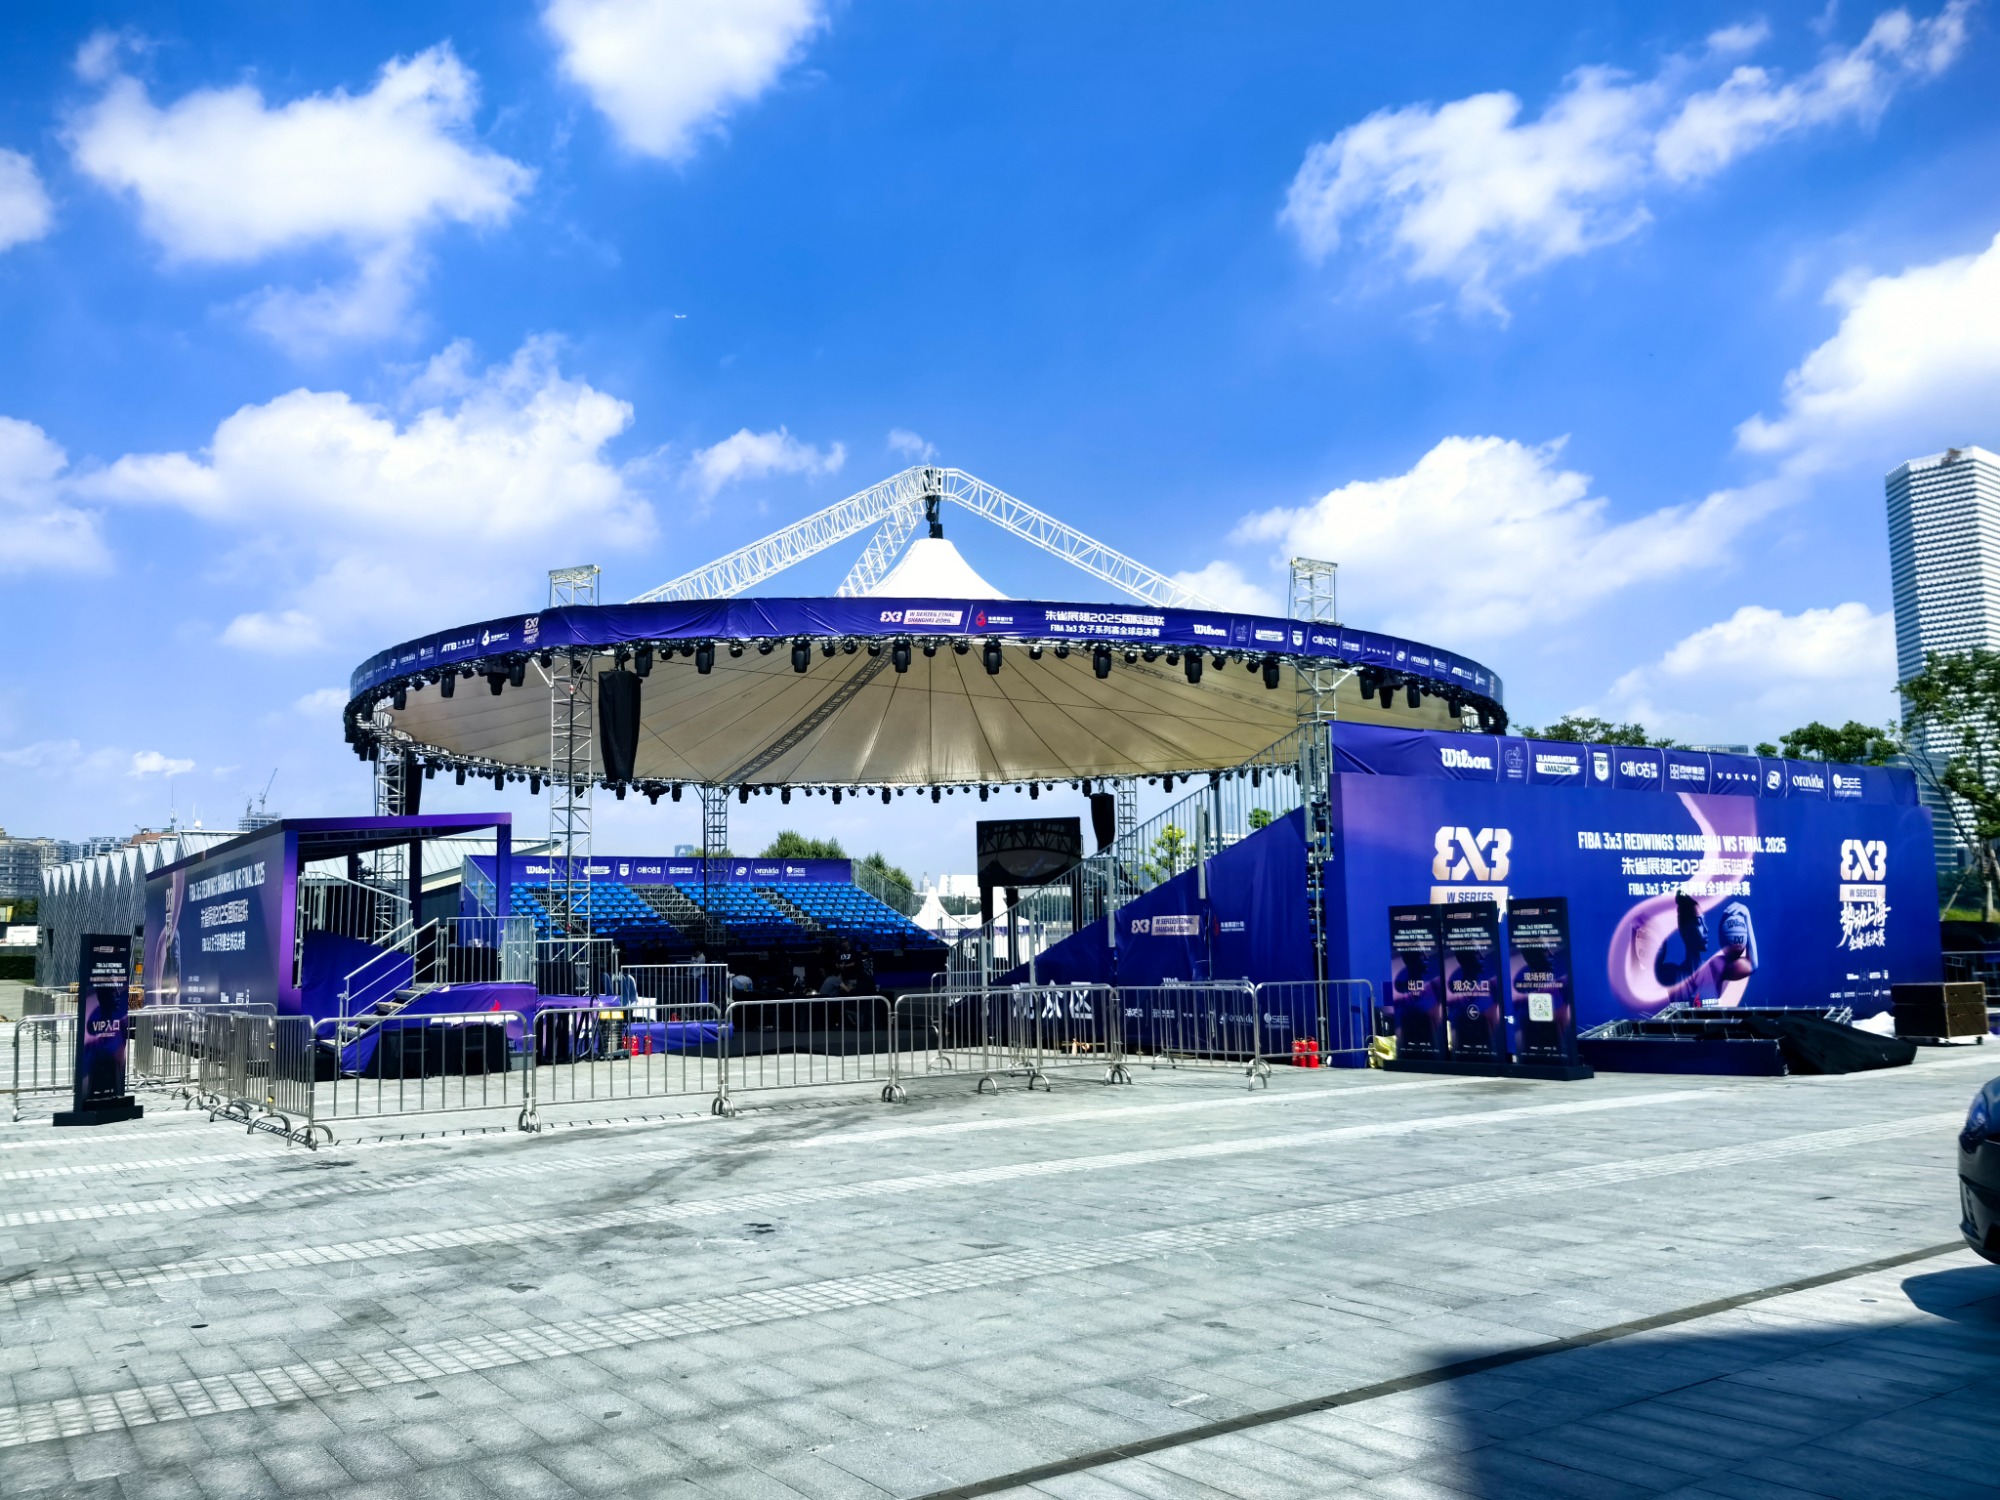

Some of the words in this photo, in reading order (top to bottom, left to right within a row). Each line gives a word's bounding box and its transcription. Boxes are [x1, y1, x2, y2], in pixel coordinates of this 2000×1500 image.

[1050, 624, 1065, 632] FIBA
[1065, 625, 1077, 633] 3x3
[1193, 624, 1227, 637] Wilson
[1440, 747, 1493, 770] Wilson
[1717, 772, 1757, 782] VOLVO
[1842, 777, 1862, 789] SEE
[1578, 831, 1601, 849] FIBA
[1603, 832, 1622, 850] 3x3
[1624, 833, 1674, 851] REDWINGS
[1676, 835, 1721, 852] SHANGHAI
[1722, 836, 1738, 852] WS
[1739, 836, 1764, 853] FINAL
[1765, 837, 1786, 853] 2025
[242, 865, 254, 889] FINAL
[254, 861, 265, 885] 2025
[525, 866, 556, 874] Wilson
[1628, 882, 1644, 896] FIBA
[1645, 882, 1659, 896] 3x3
[1849, 889, 1855, 897] W
[1856, 889, 1877, 897] SERIES
[1447, 892, 1456, 903] W
[1458, 892, 1494, 902] SERIES
[1523, 972, 1554, 981] 现场预约
[1407, 980, 1425, 991] 出口
[1452, 980, 1490, 991] 观众入口
[93, 1020, 120, 1031] VIP入口
